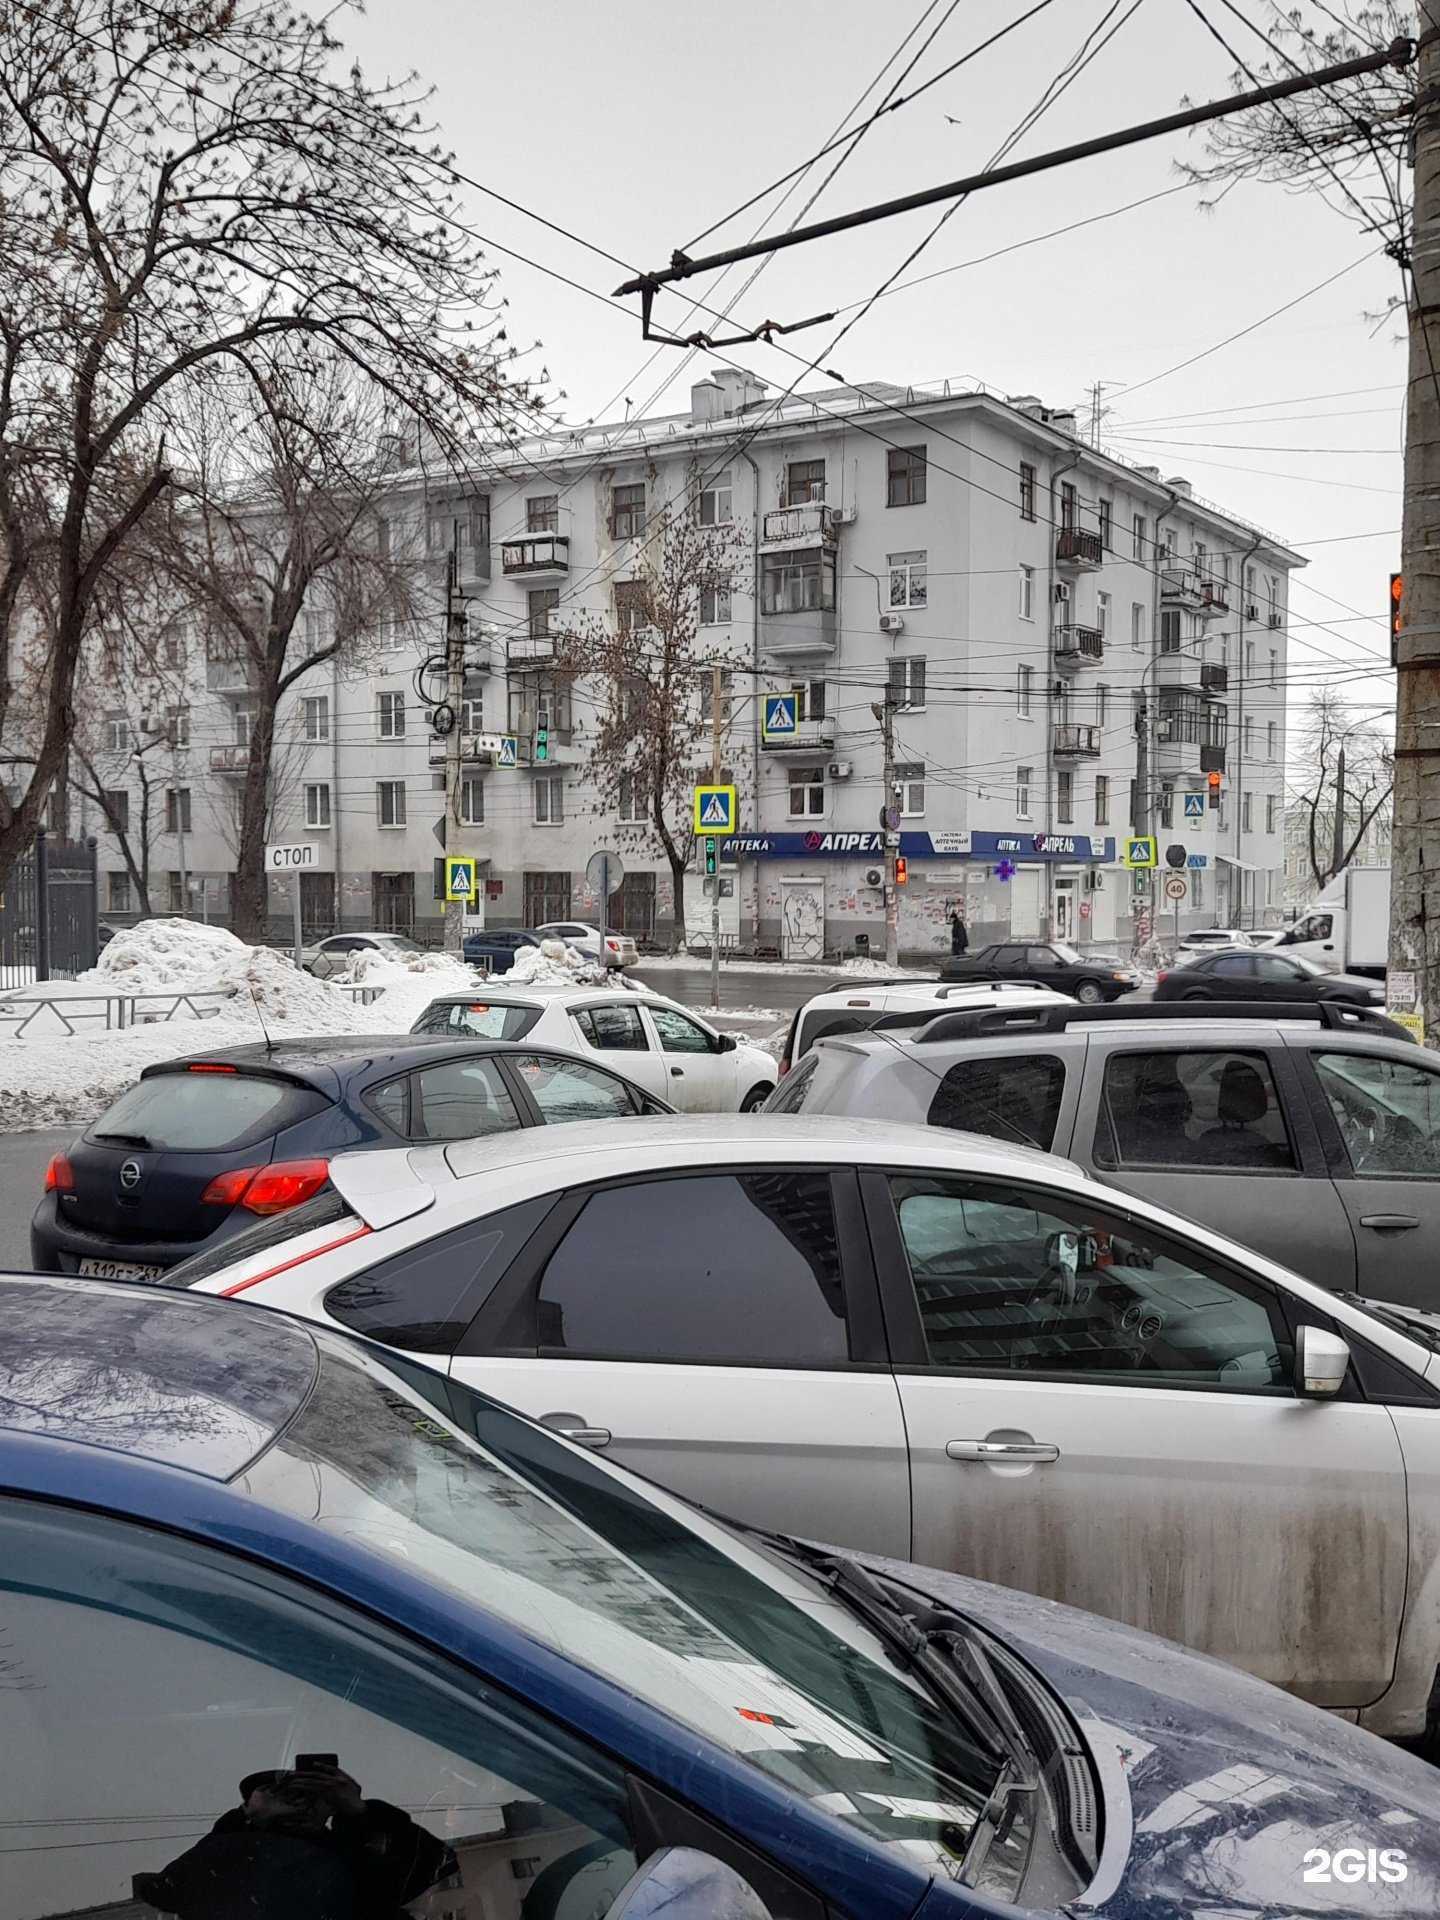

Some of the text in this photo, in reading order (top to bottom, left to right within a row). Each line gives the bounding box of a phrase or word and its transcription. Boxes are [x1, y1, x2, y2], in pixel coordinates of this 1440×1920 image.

[723, 839, 769, 851] АПТЕКА
[820, 834, 884, 851] АПРЕЛ
[1043, 836, 1075, 853] АПРЕЛЬ
[273, 847, 312, 866] СТОП
[1170, 885, 1183, 894] 40
